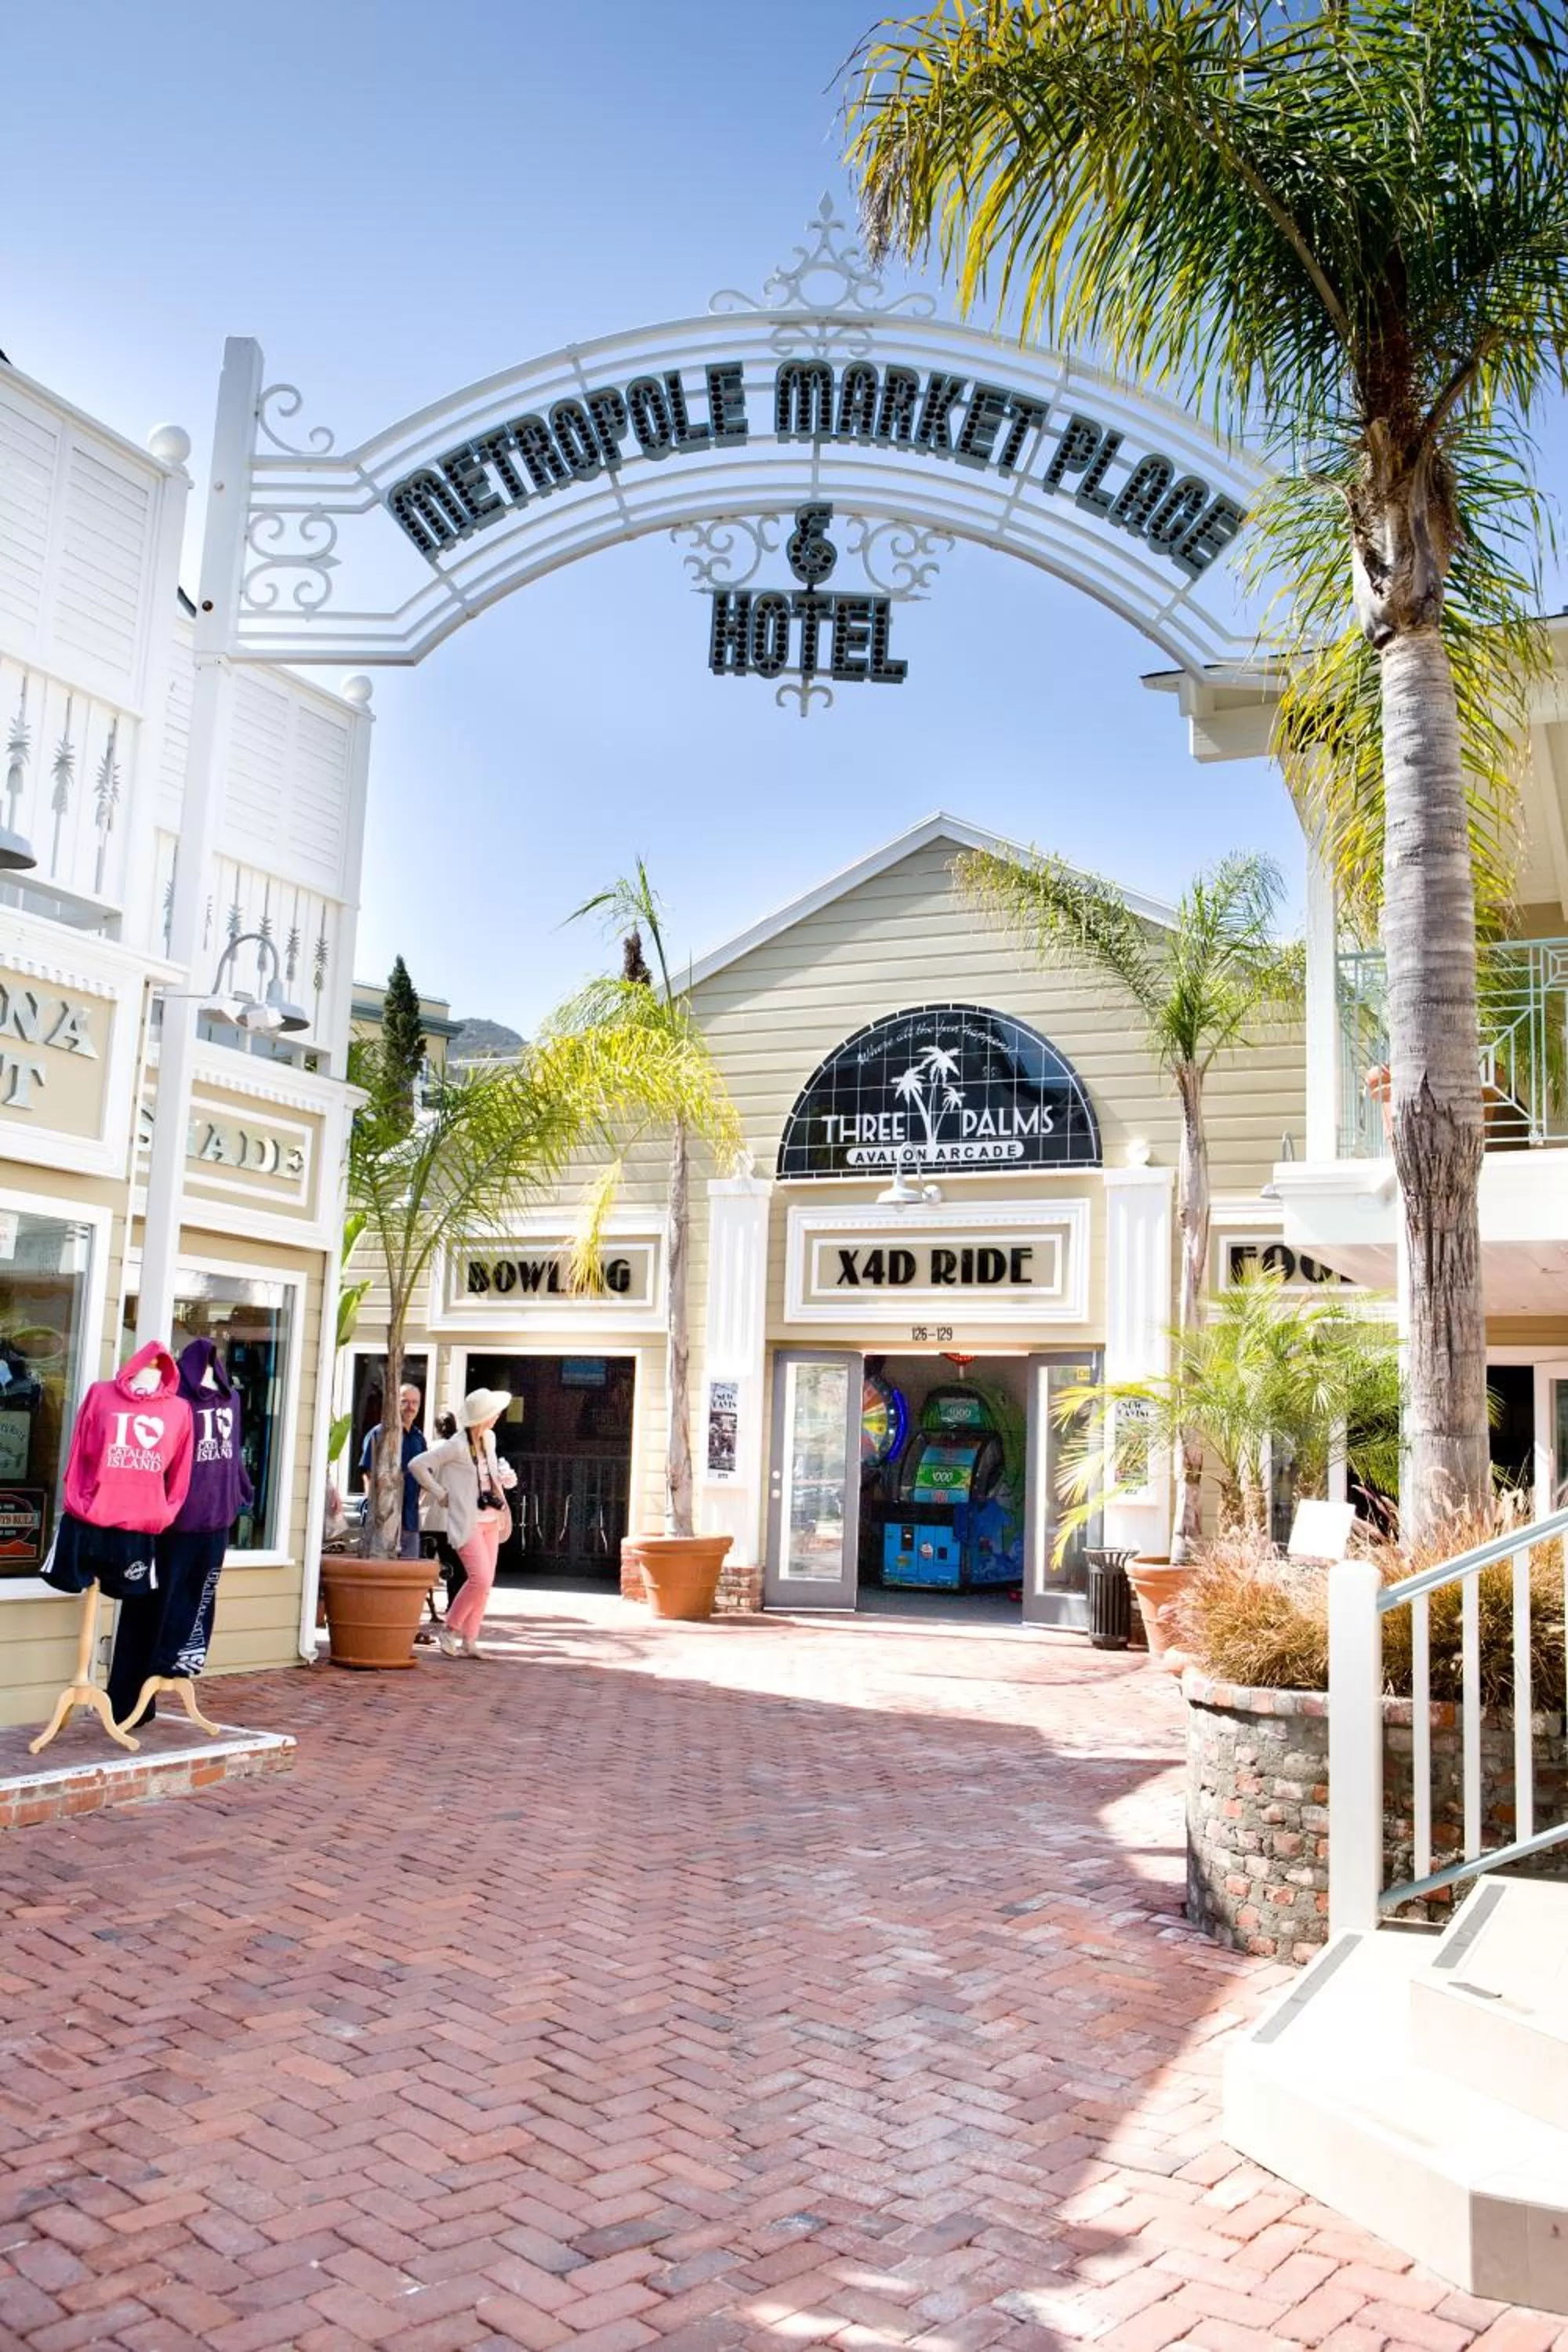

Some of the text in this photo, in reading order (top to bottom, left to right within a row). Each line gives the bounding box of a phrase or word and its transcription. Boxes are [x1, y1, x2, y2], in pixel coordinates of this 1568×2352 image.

[387, 359, 1251, 579] METROPOLE MARKET PLACE
[709, 590, 908, 684] HOTEL
[822, 1105, 1054, 1143] THREE PALMS
[855, 1145, 1018, 1163] AVALON ARCADE
[837, 1247, 1032, 1286] X4D RIDE
[912, 1327, 953, 1341] 126-129
[112, 1412, 132, 1447] I
[107, 1456, 162, 1472] ISLAND
